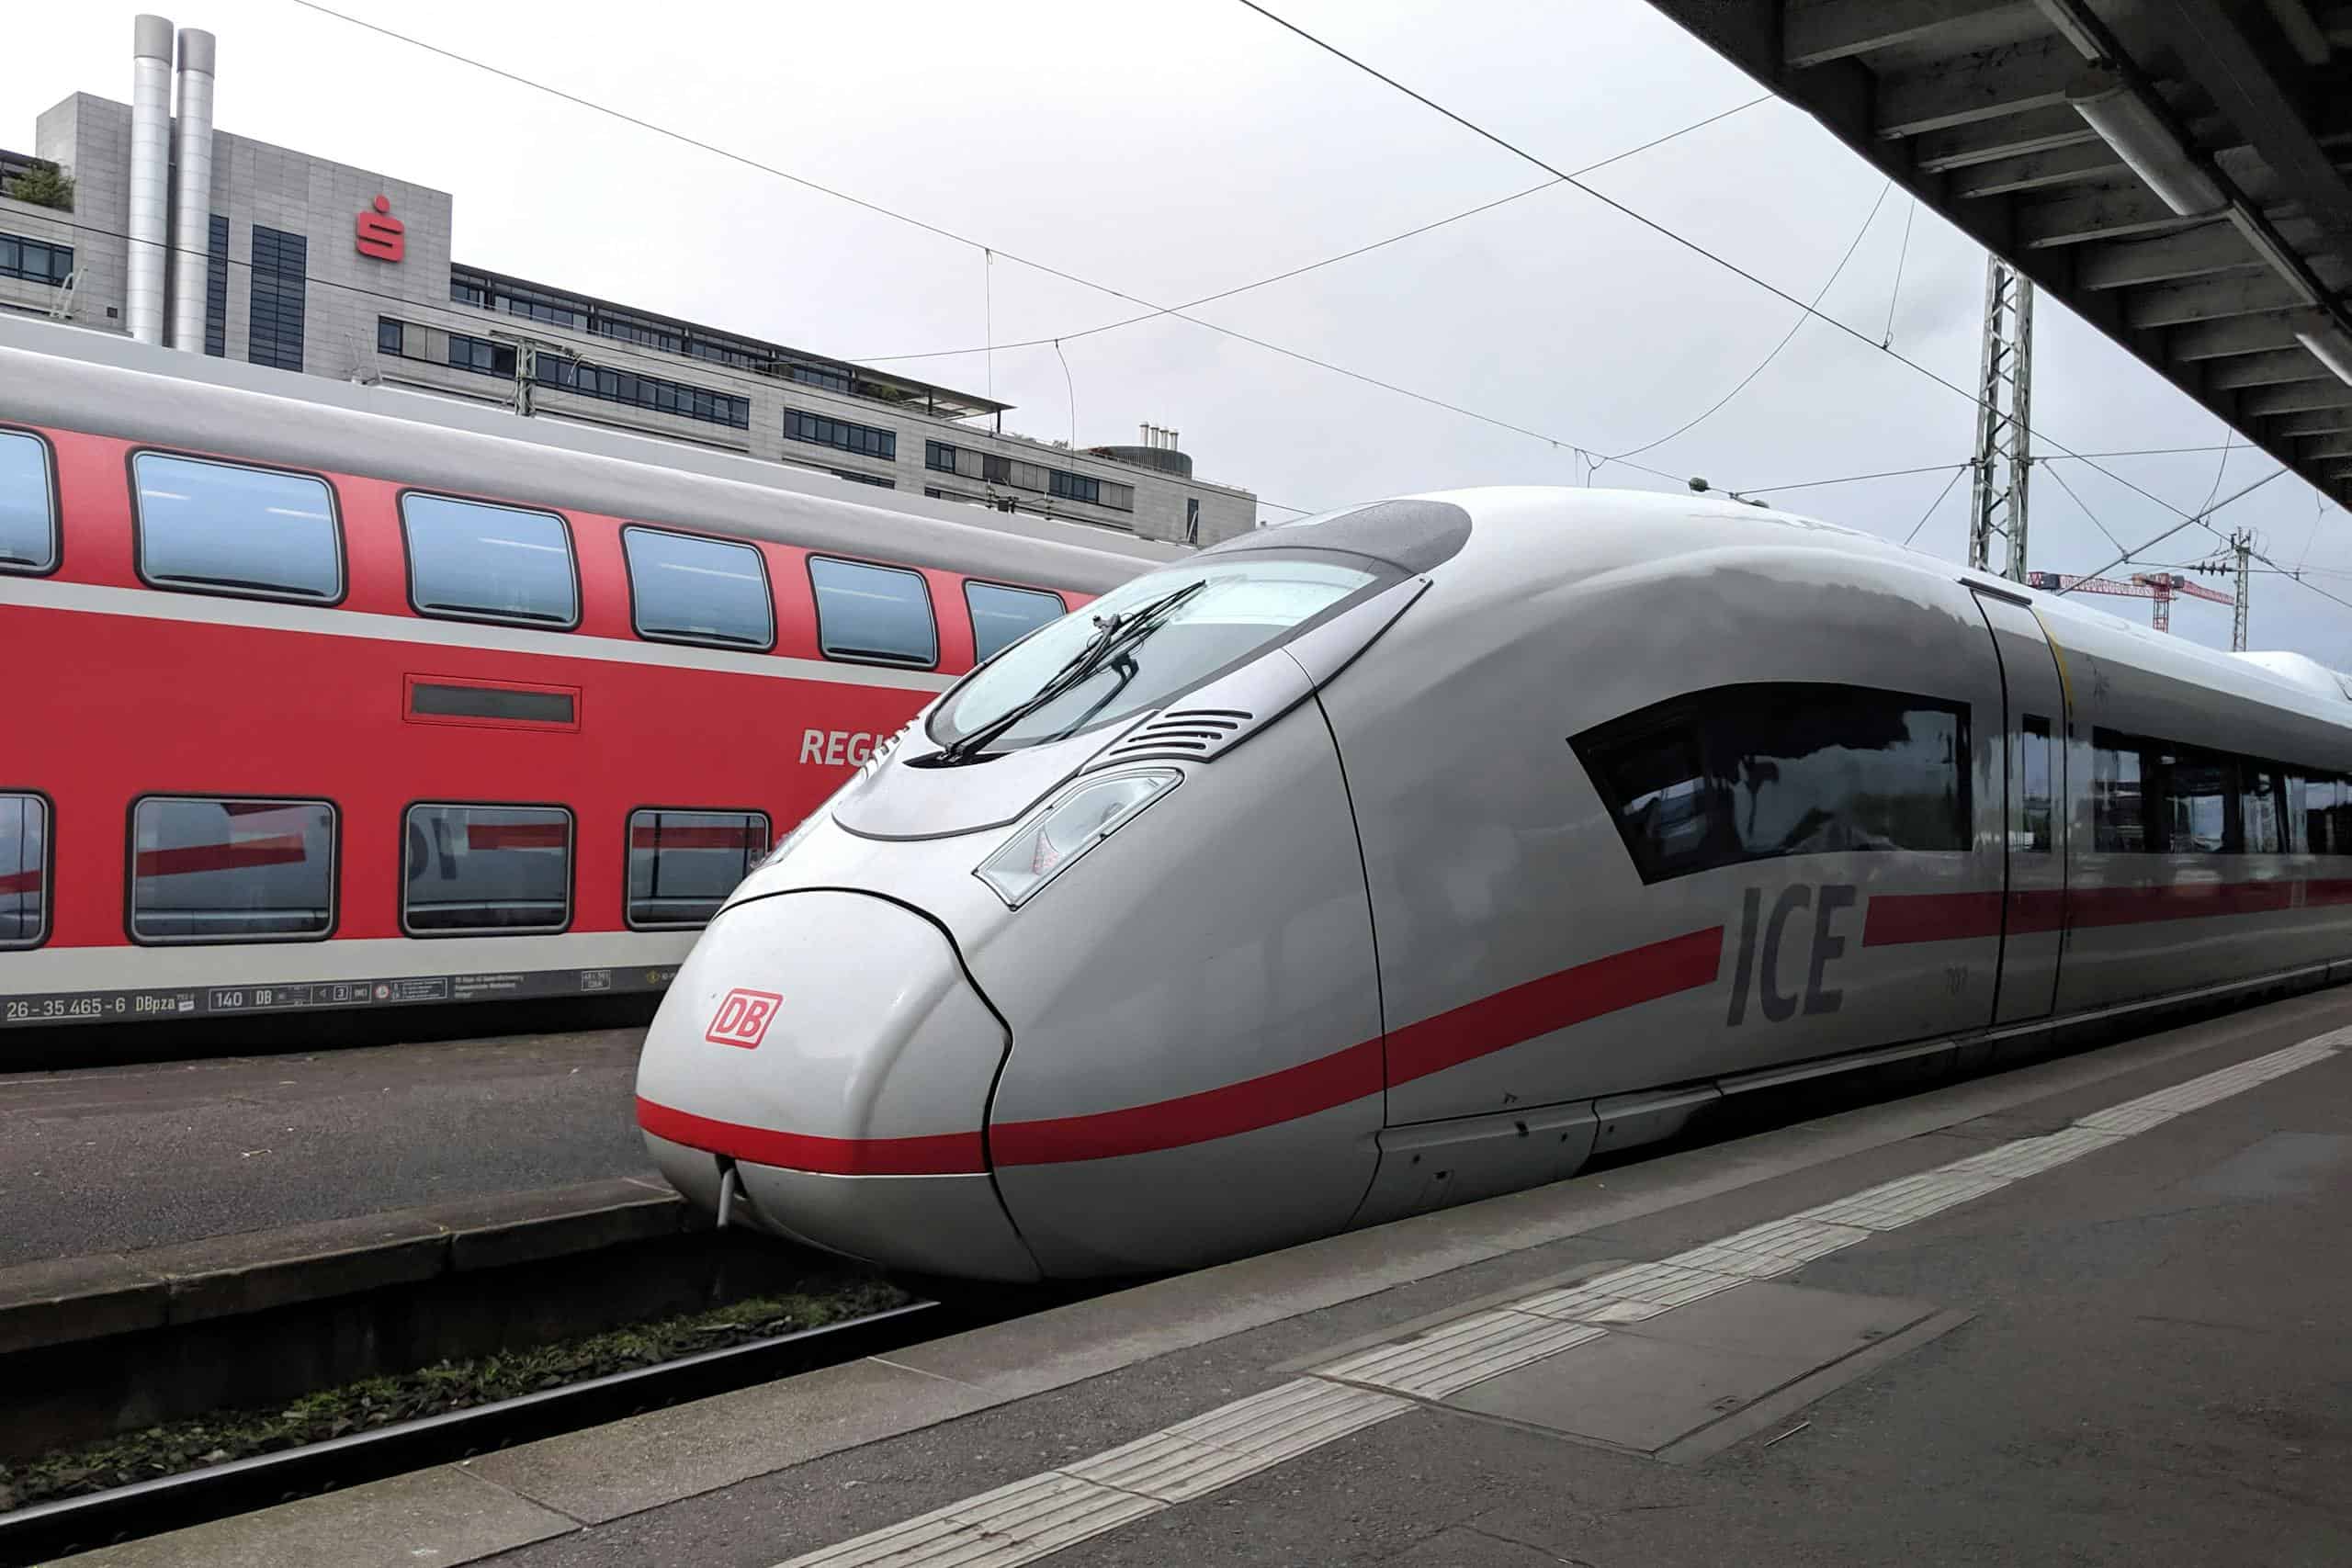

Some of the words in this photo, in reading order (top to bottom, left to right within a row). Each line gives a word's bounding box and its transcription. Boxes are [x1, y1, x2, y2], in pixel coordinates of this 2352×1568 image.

[1726, 883, 1856, 1027] ICE
[135, 996, 175, 1014] DBpza
[215, 991, 243, 1008] 140
[256, 990, 273, 1006] DB
[715, 998, 770, 1037] DB
